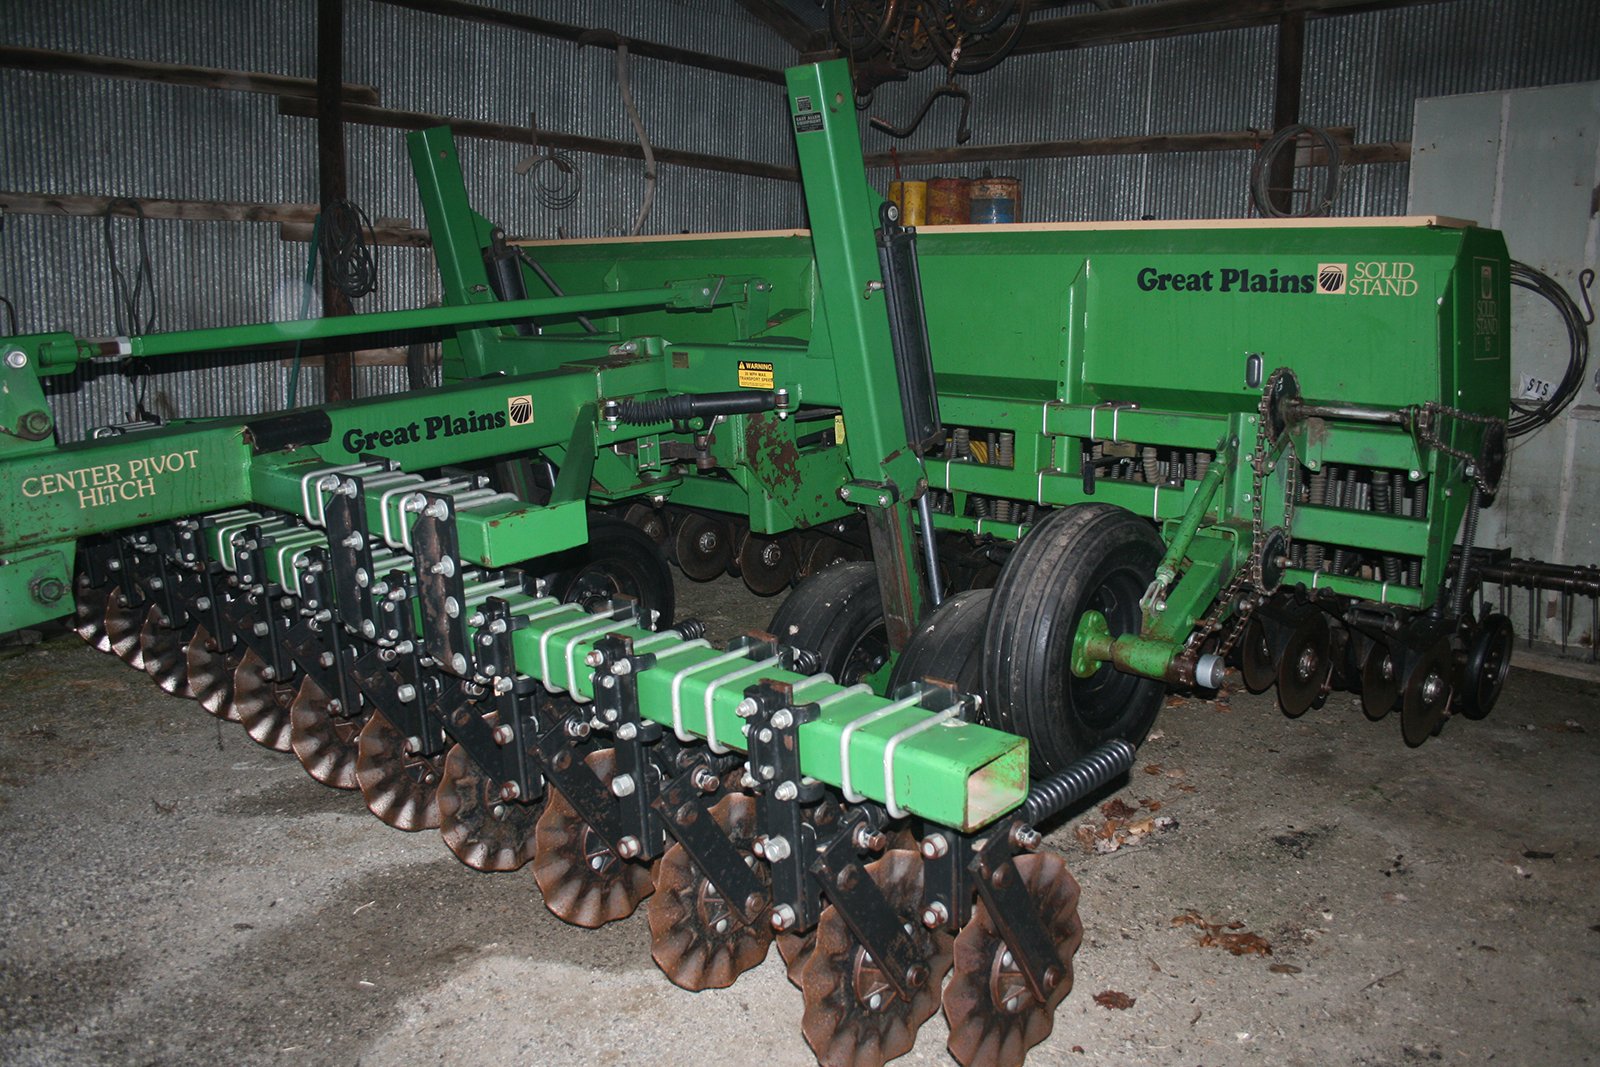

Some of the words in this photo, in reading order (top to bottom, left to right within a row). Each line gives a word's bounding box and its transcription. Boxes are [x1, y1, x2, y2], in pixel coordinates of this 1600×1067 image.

[1353, 261, 1414, 280] SOLID
[1137, 267, 1213, 293] Great
[1219, 268, 1315, 294] Plains
[1348, 279, 1419, 297] STAND
[1477, 300, 1496, 317] SOLID
[1475, 318, 1498, 335] STAND
[745, 362, 772, 370] WARNING
[1526, 378, 1549, 396] STS
[342, 422, 421, 454] Great
[423, 410, 507, 441] Plains
[22, 463, 123, 498] CENTER
[128, 450, 199, 479] PIVOT
[77, 478, 156, 509] HITCH
